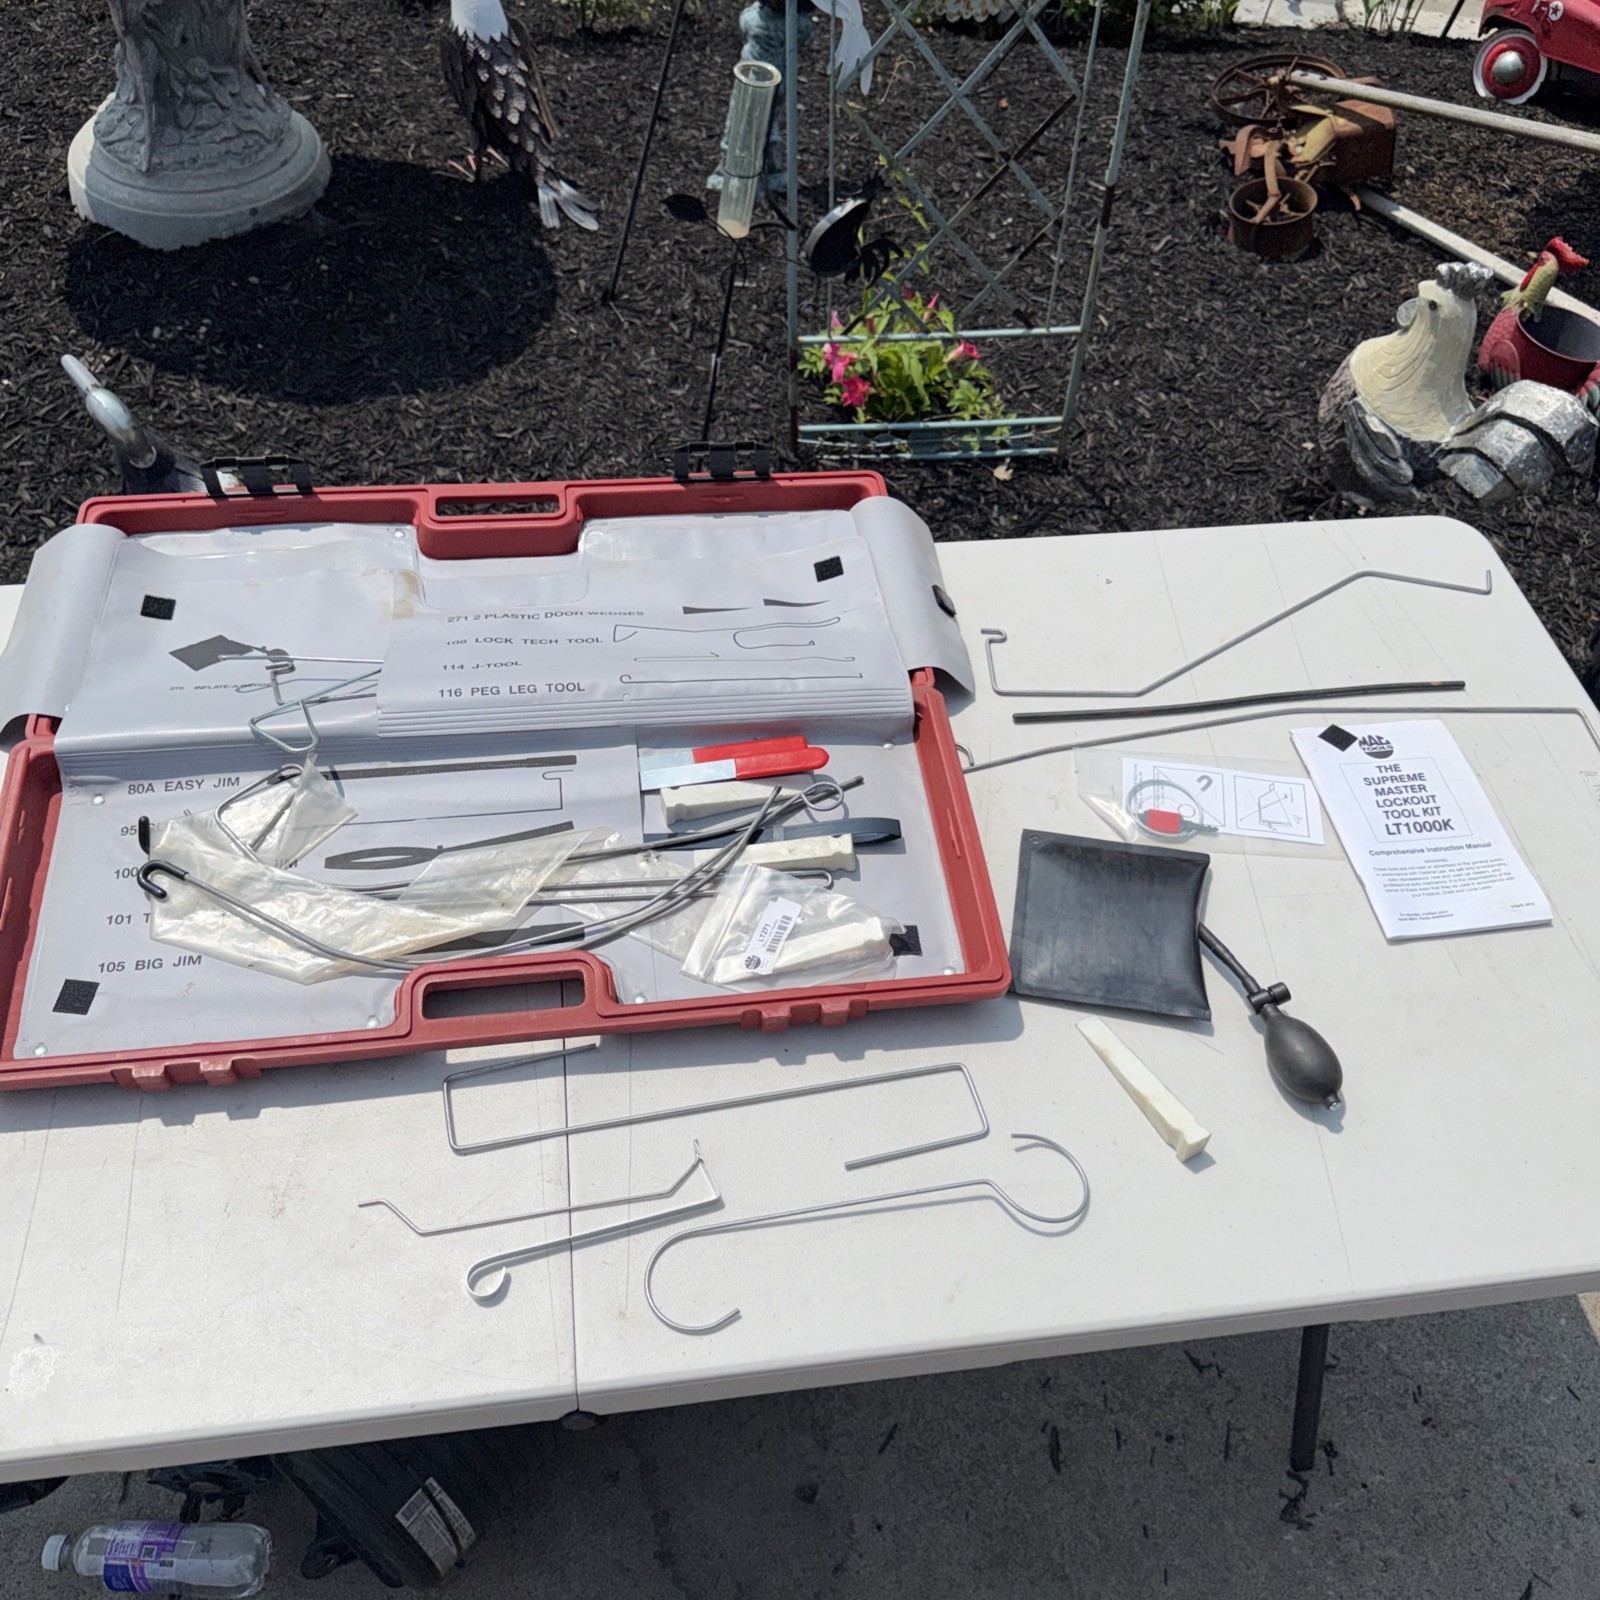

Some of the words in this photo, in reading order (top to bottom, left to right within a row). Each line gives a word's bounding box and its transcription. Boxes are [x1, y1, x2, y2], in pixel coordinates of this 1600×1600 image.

[447, 615, 468, 623] 271
[472, 661, 522, 669] J-TOOL
[438, 688, 462, 698] 116
[470, 686, 500, 696] PEG
[509, 684, 538, 694] LEG
[546, 682, 586, 692] TOOL
[1358, 734, 1391, 747] MAC
[1376, 764, 1402, 774] THE
[128, 783, 155, 795] 80A
[164, 779, 205, 792] EASY
[214, 777, 240, 788] JIM
[1363, 772, 1426, 786] SUPREME
[1374, 784, 1428, 796] MASTER
[1376, 794, 1437, 808] LOCKOUT
[1382, 808, 1420, 820] TOOL
[1422, 806, 1441, 817] KIT
[120, 826, 138, 836] 95
[1385, 818, 1455, 836] LT1000K
[1369, 848, 1424, 856] Comprehensive
[1426, 844, 1464, 853] Instruction
[114, 866, 138, 880] 100
[106, 914, 132, 925] 101
[758, 924, 770, 942] LT271
[98, 962, 126, 973] 105
[134, 958, 164, 970] BIG
[172, 955, 202, 968] JIM
